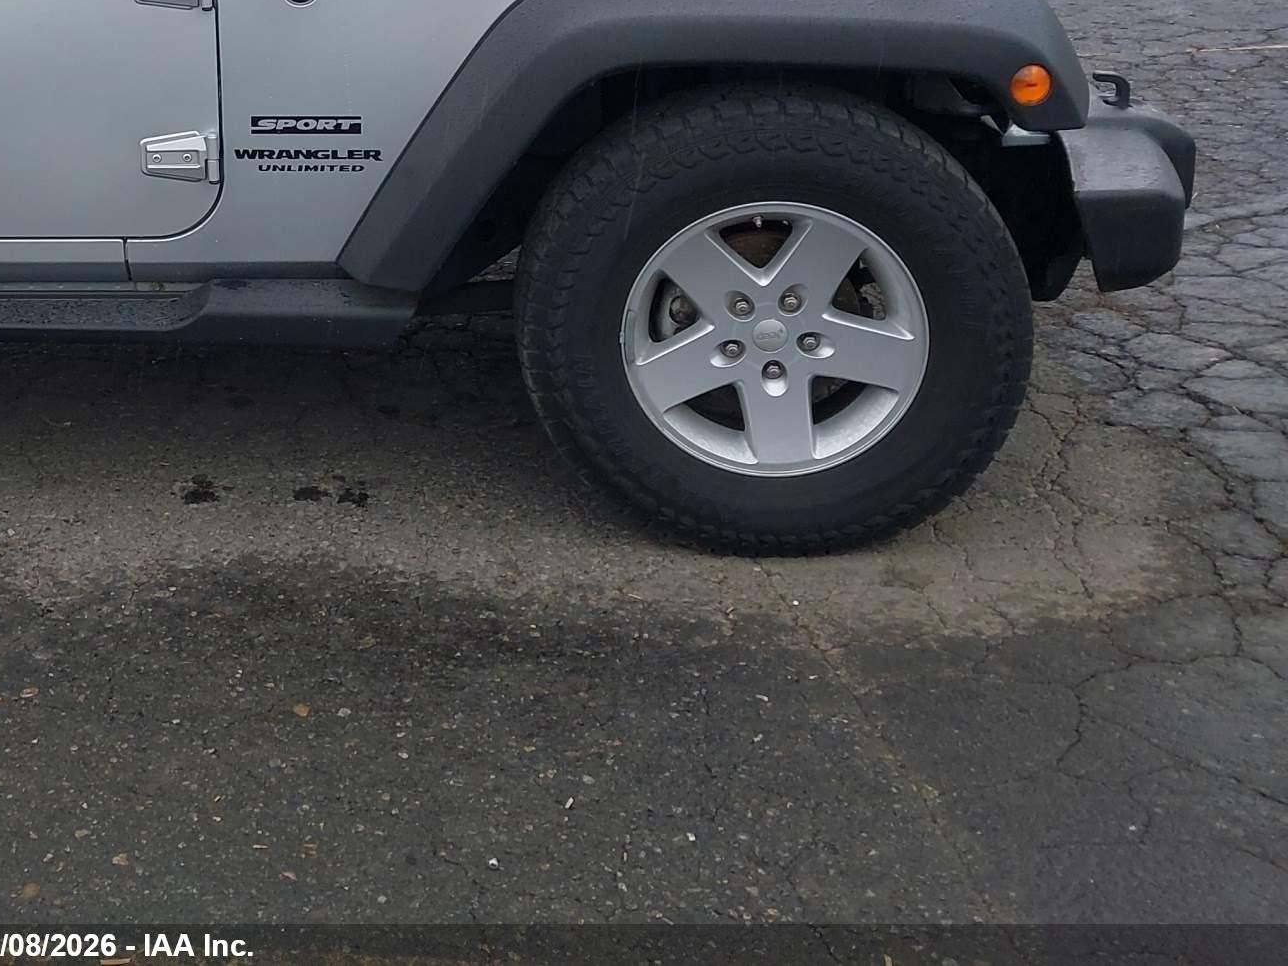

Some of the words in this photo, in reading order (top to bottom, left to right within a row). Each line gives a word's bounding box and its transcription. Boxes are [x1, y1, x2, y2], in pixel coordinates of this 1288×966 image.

[257, 119, 361, 130] SPORT
[235, 149, 383, 161] WRANGLER
[258, 164, 364, 172] UNLIMITED
